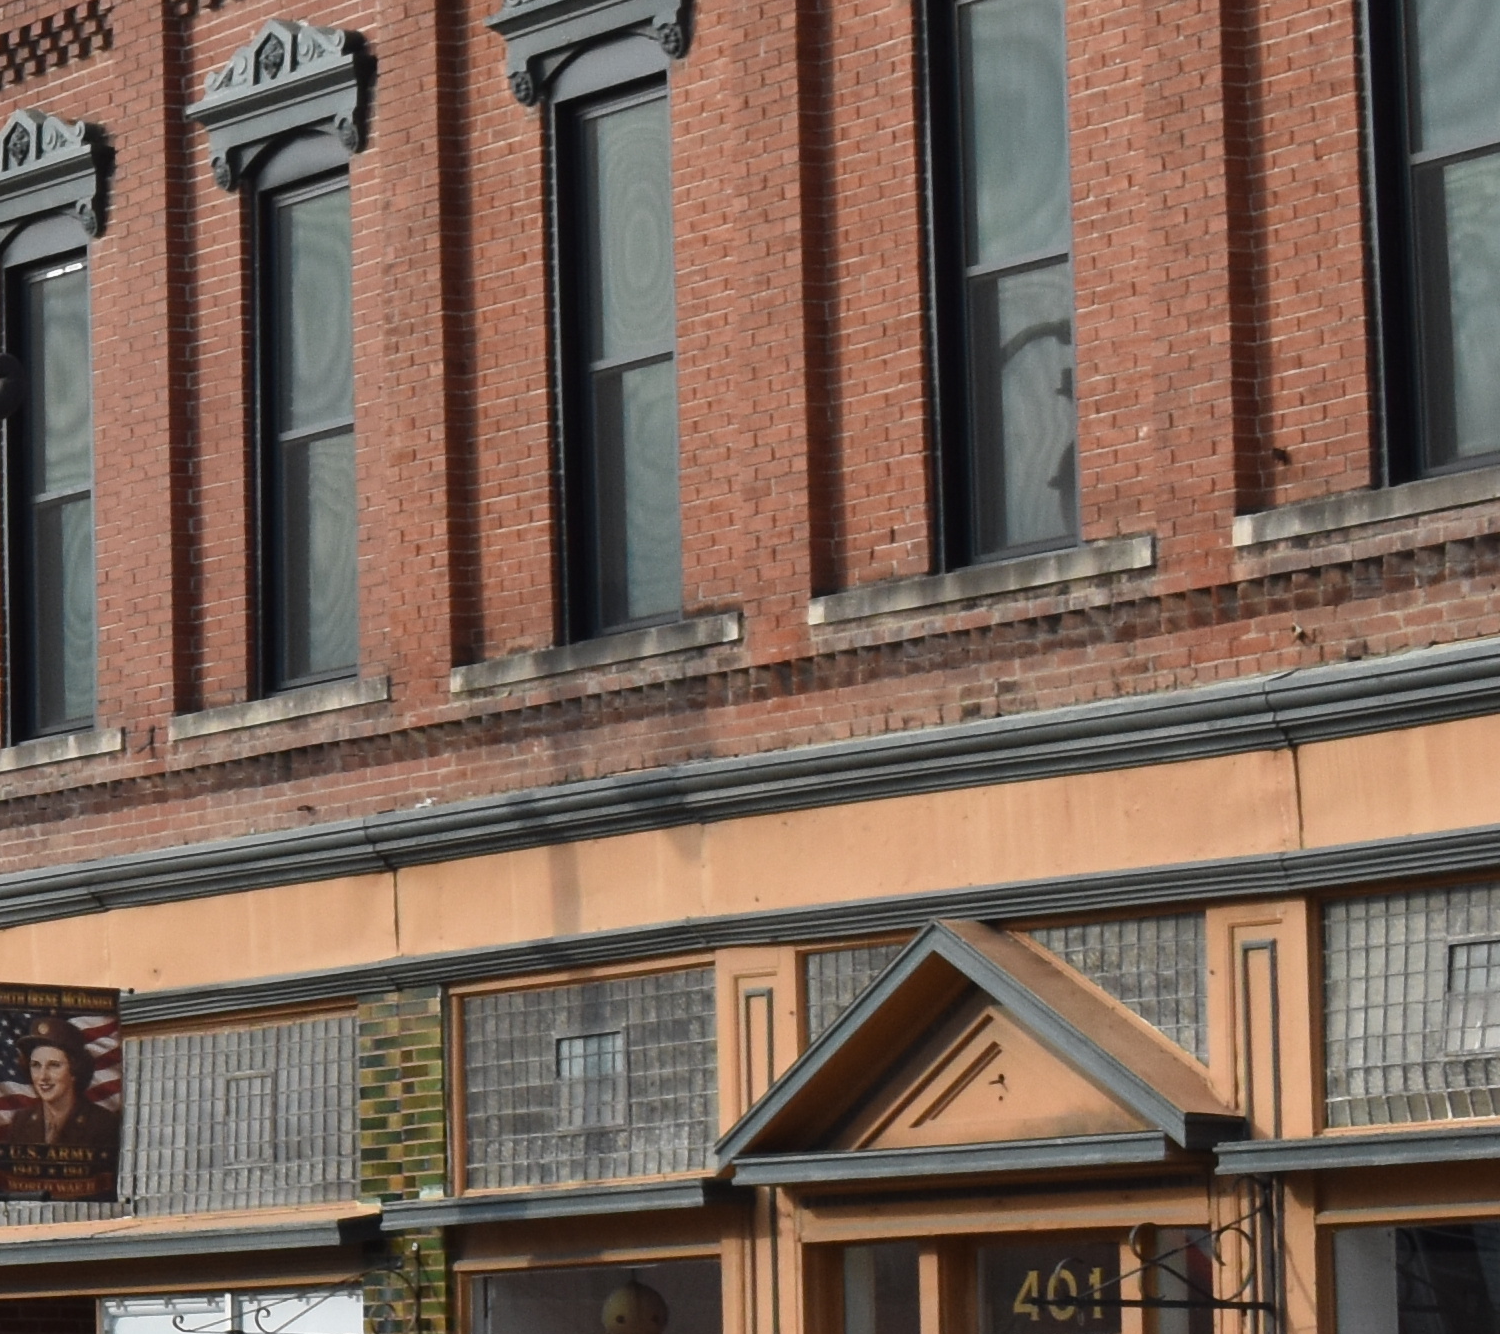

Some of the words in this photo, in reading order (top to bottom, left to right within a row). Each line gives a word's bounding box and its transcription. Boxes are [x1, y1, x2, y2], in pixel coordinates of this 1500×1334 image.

[27, 990, 59, 1006] IRENE
[9, 1147, 42, 1160] U.S.
[47, 1147, 93, 1161] ARMY
[7, 1179, 54, 1192] WORLD
[56, 1181, 84, 1193] WAR
[1013, 1267, 1103, 1322] 401
